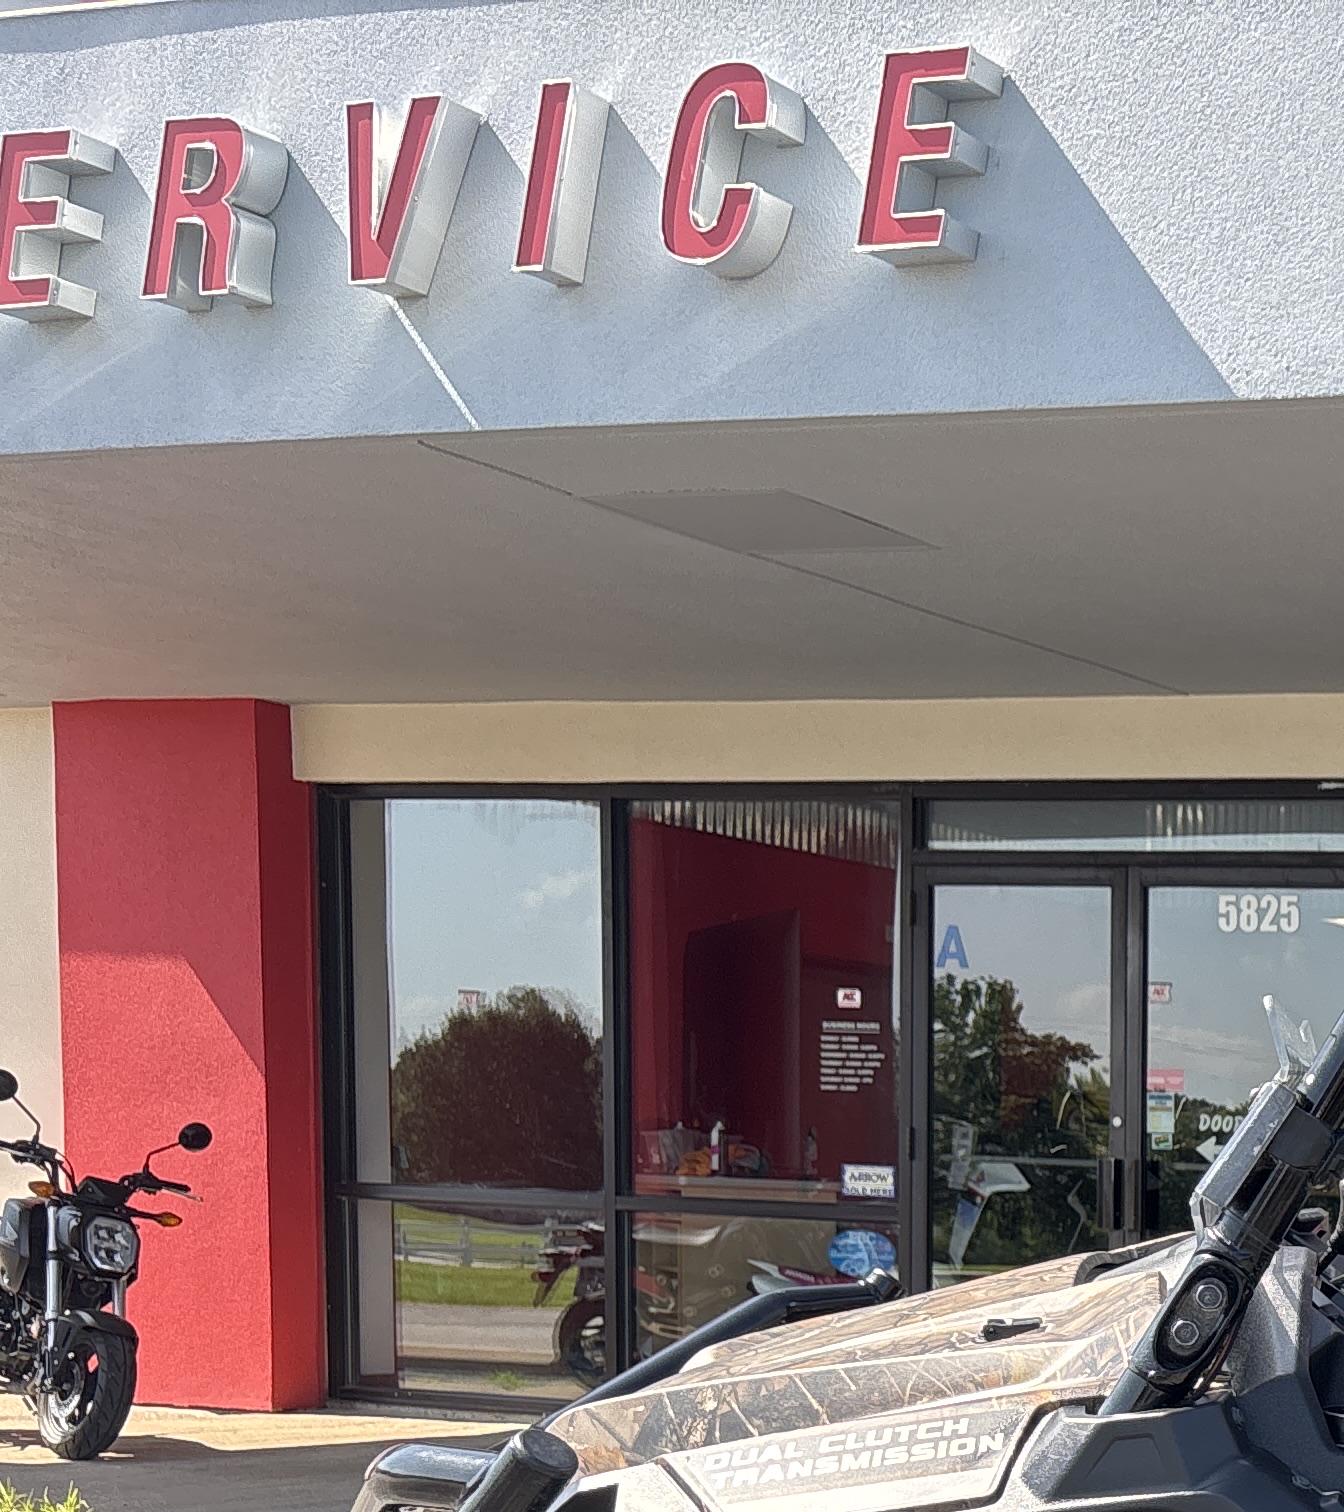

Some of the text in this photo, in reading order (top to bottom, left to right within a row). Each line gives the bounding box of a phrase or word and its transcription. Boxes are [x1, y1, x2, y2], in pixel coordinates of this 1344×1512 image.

[1217, 894, 1301, 933] 5825
[702, 1417, 969, 1472] DUAL CLUTCH
[710, 1432, 1005, 1490] TRANSMISSION
